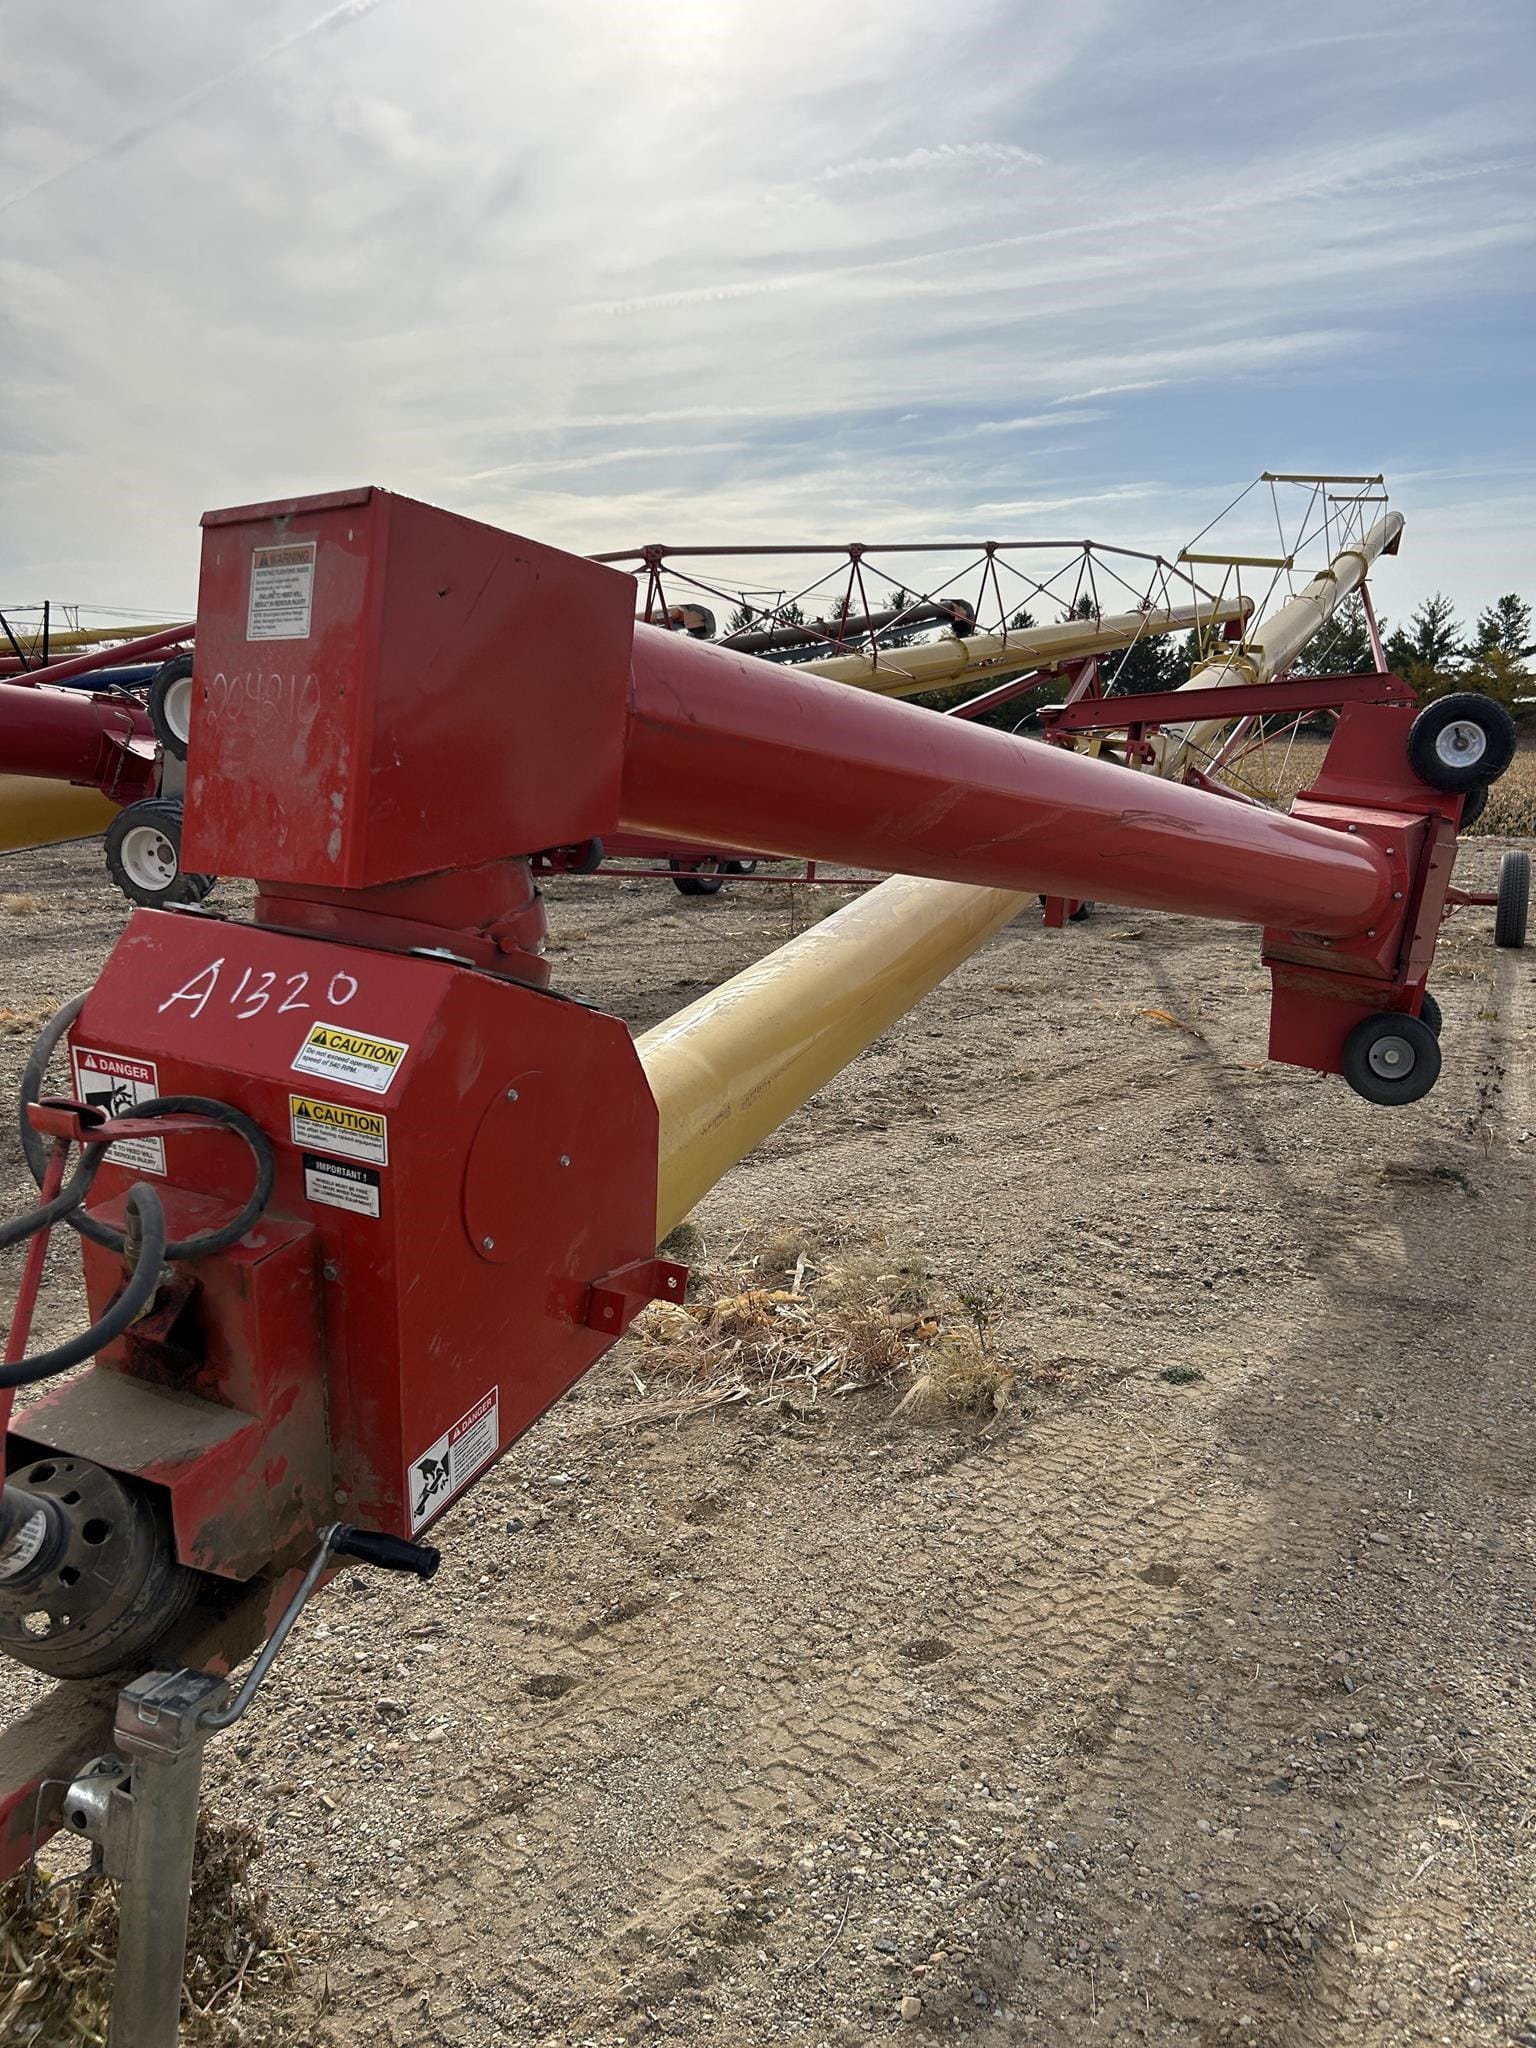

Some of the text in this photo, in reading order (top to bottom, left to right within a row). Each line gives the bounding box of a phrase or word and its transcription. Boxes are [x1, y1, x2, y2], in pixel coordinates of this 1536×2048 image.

[330, 1035, 399, 1063] CAUTION
[302, 1055, 321, 1066] speed
[322, 1059, 329, 1067] of
[329, 1061, 341, 1070] 540
[306, 1047, 380, 1072] Do not exceed operating
[100, 1059, 149, 1080] DANGER
[313, 1106, 381, 1134] CAUTION
[307, 1126, 319, 1134] after
[320, 1129, 337, 1139] having
[338, 1134, 354, 1142] raised
[141, 1150, 154, 1159] WILL
[315, 1161, 362, 1180] IMPORTANT
[323, 1184, 336, 1192] MOVE
[335, 1182, 349, 1190] MUST
[356, 1187, 368, 1196] FREE
[461, 1397, 493, 1433] DANGER
